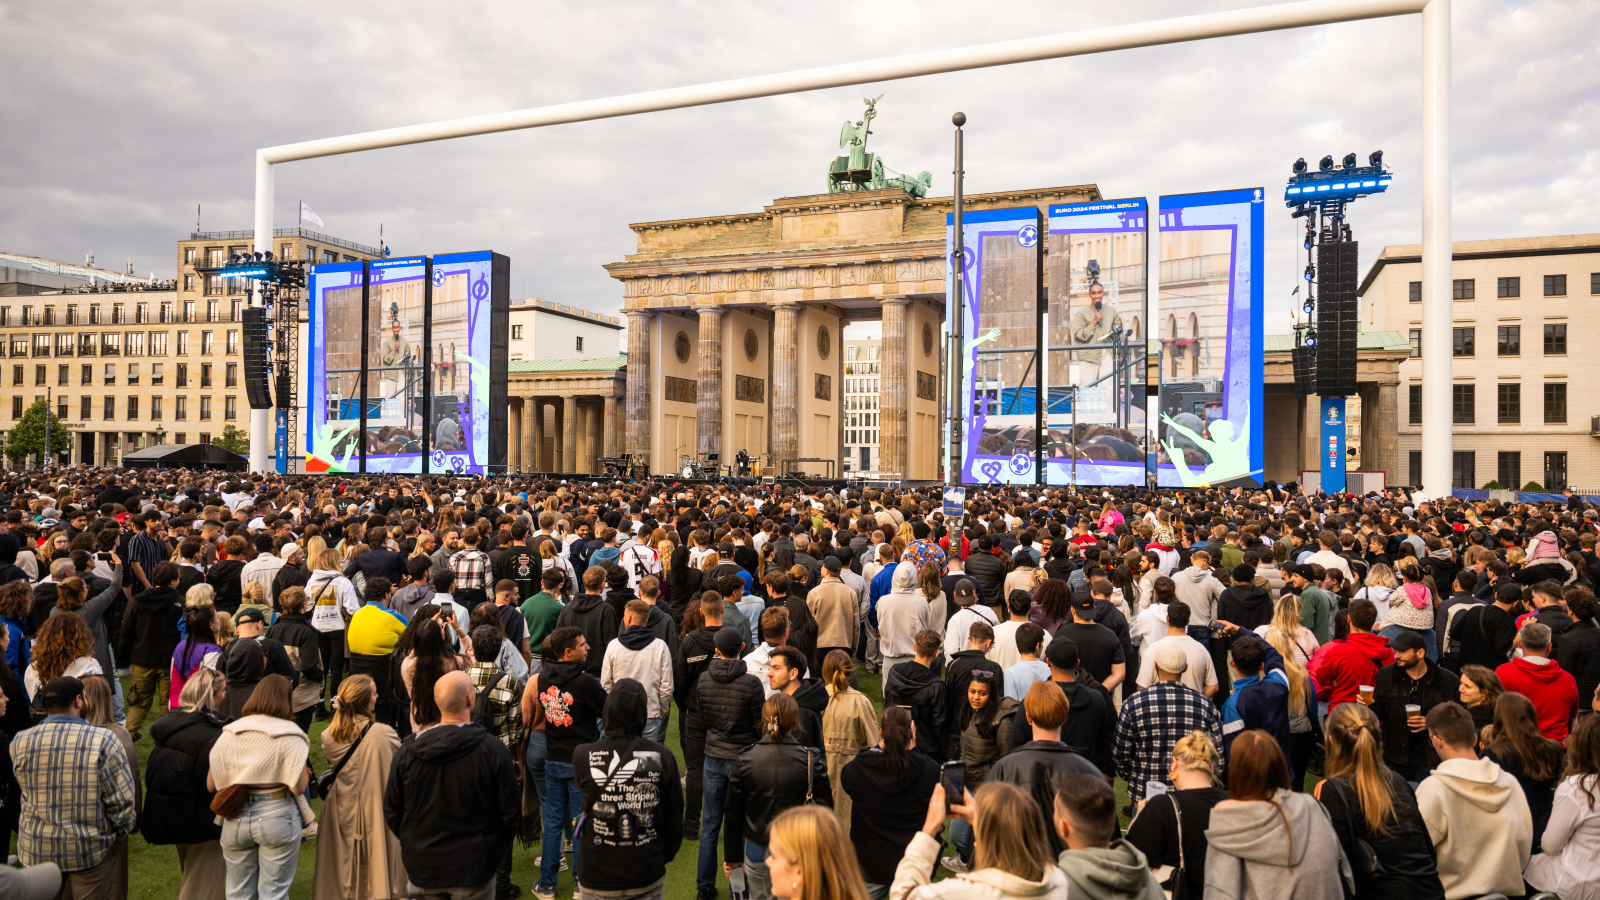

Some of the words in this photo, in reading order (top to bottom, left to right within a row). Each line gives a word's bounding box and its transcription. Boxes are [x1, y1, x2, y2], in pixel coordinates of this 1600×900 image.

[617, 784, 634, 792] The
[600, 793, 624, 802] three
[625, 793, 654, 801] Stripes
[617, 801, 642, 810] World
